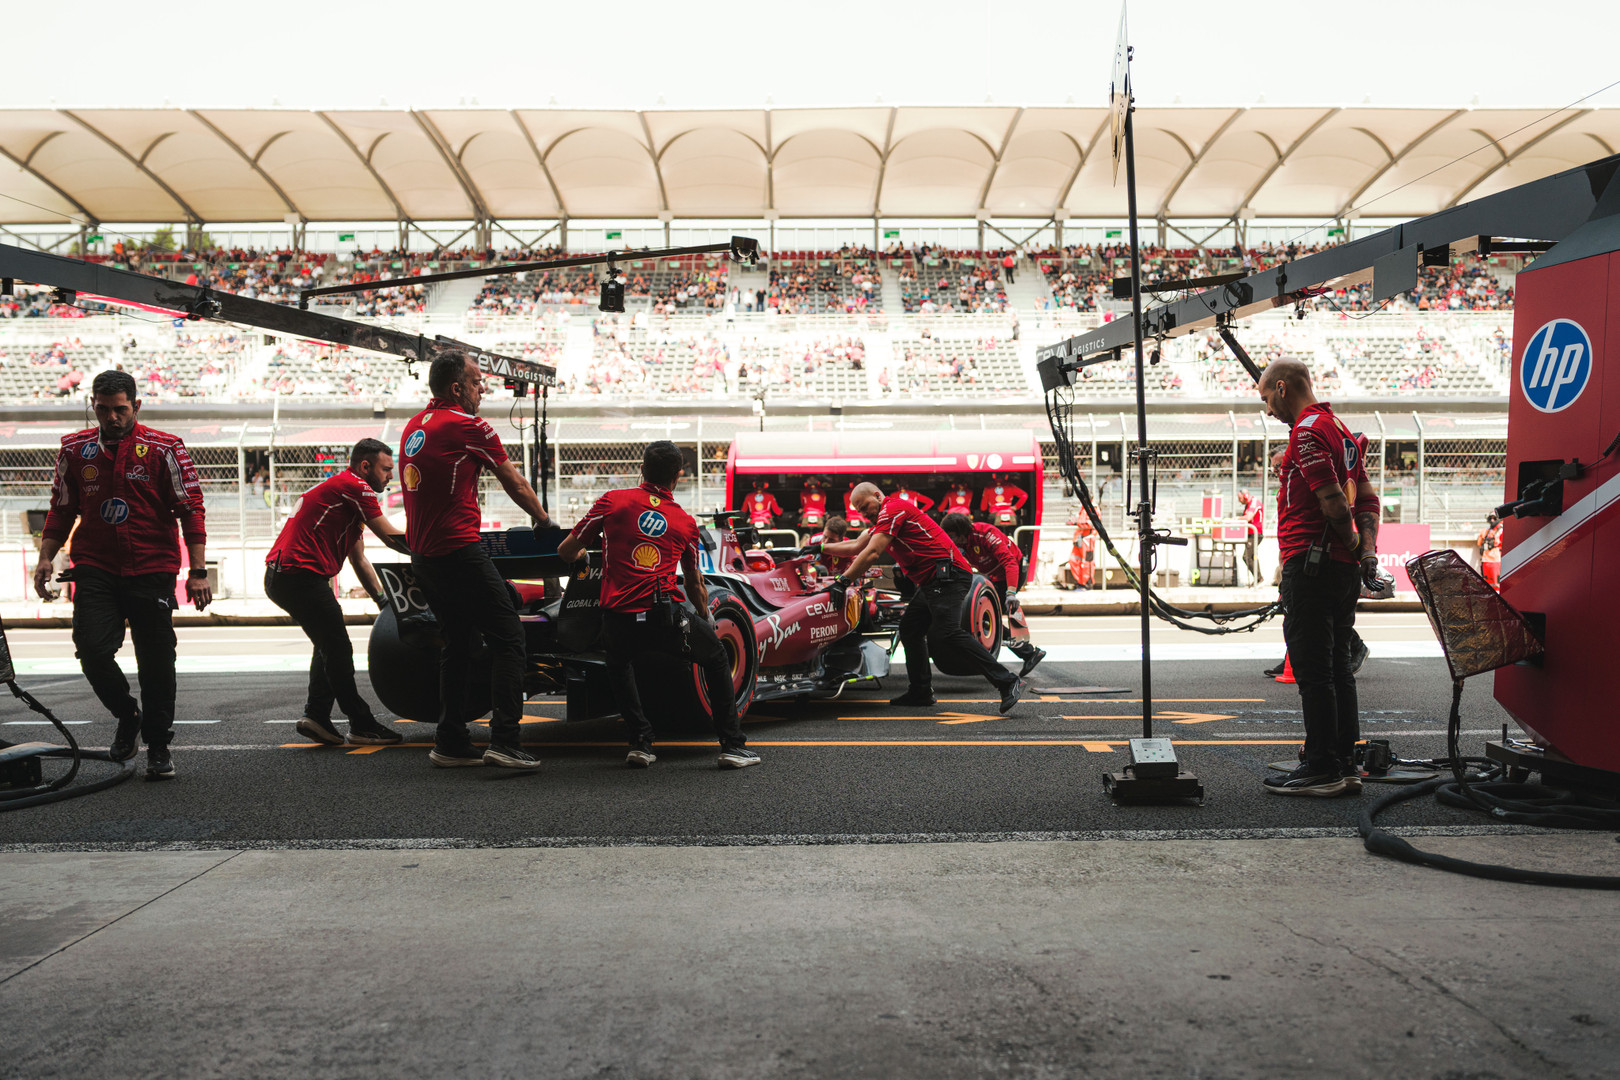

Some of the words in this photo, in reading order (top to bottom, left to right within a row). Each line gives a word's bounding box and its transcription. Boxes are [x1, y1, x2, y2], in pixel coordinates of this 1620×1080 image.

[1071, 338, 1105, 356] OGISTICS
[468, 352, 512, 376] EVA
[513, 368, 556, 384] LOGISTICS
[1528, 319, 1585, 412] hp
[84, 442, 98, 459] hp
[406, 431, 424, 456] hp
[103, 498, 127, 524] hp
[640, 510, 666, 537] hp
[769, 577, 790, 592] IBM
[567, 600, 592, 608] GLOBAL
[810, 624, 838, 639] PERONI
